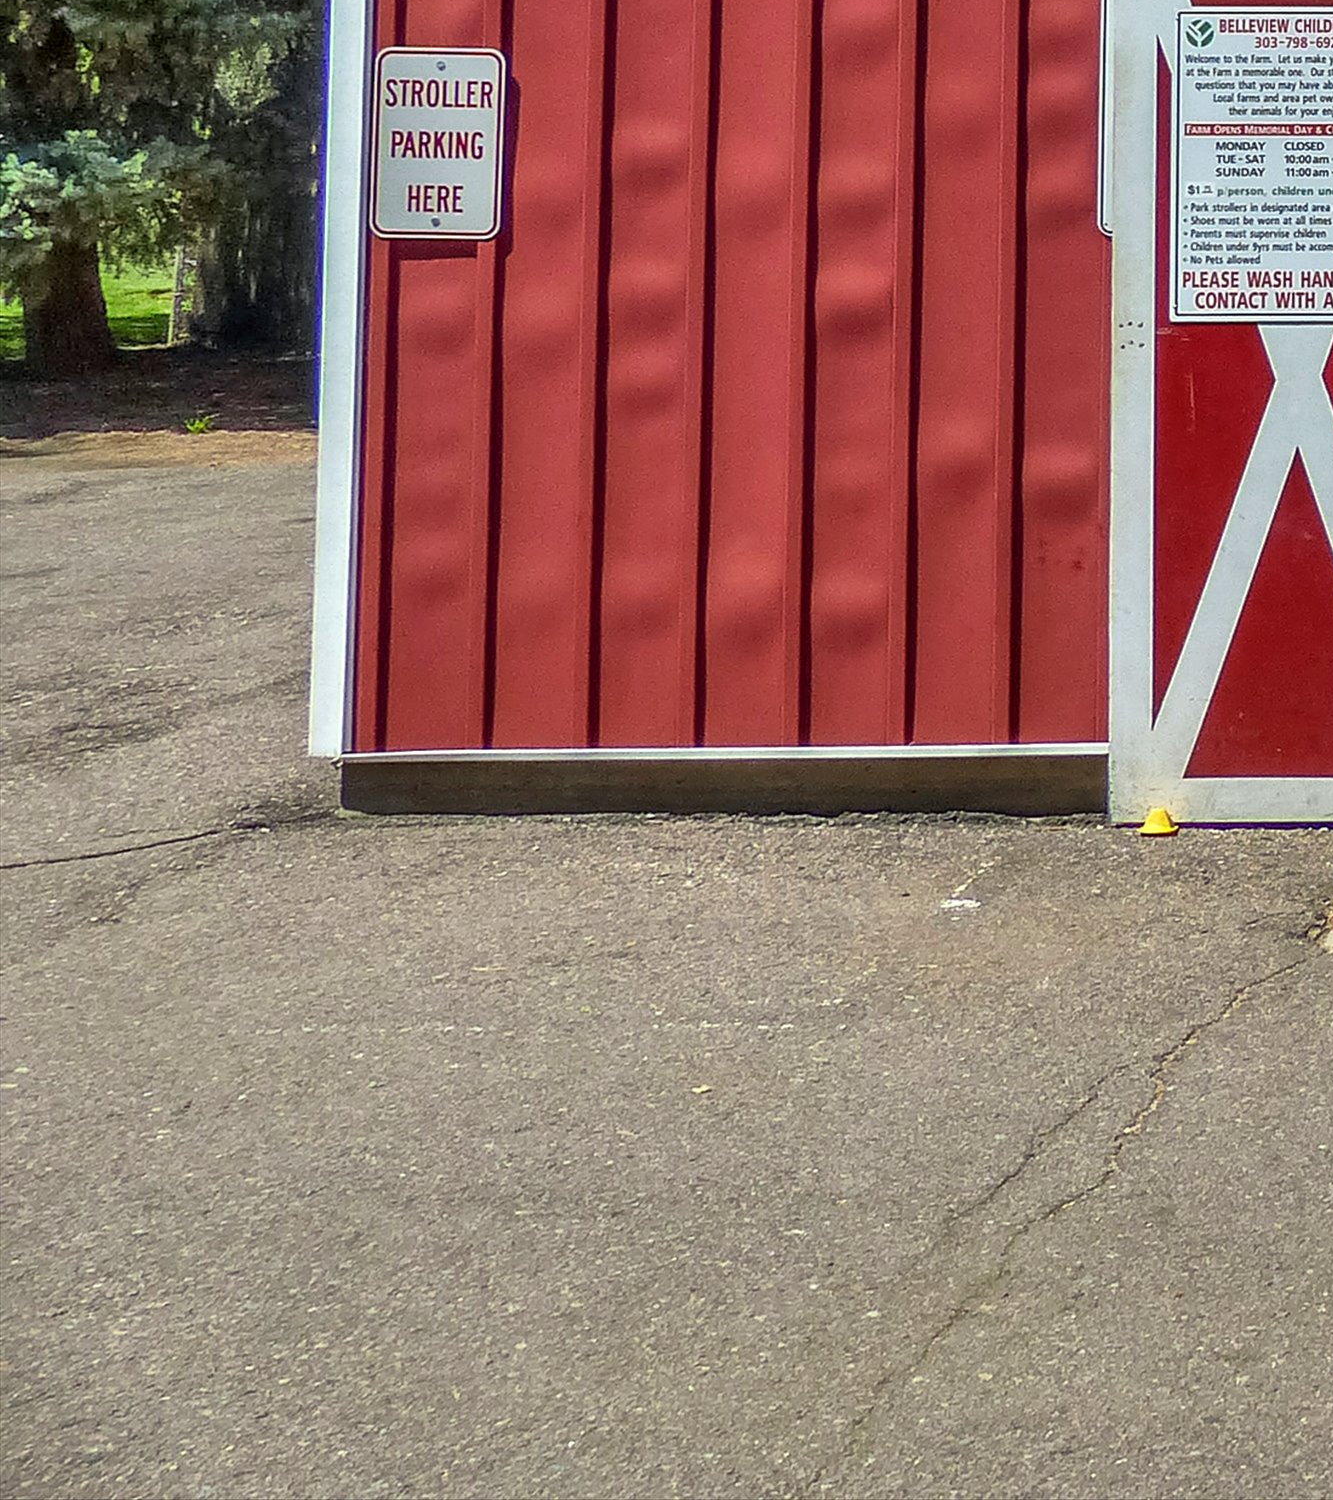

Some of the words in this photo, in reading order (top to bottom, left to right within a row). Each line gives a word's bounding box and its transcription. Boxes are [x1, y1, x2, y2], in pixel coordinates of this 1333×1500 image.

[1219, 19, 1289, 33] BELLEVIEW
[1185, 54, 1220, 63] Welcome
[1224, 55, 1232, 63] to
[1236, 54, 1248, 63] the
[1278, 55, 1290, 63] Let
[1305, 54, 1326, 63] make
[1197, 68, 1210, 76] the
[1213, 68, 1231, 76] Farm
[1242, 68, 1285, 76] memorable
[1311, 68, 1325, 76] Our
[1195, 82, 1235, 91] questions
[1239, 81, 1256, 89] that
[1260, 83, 1275, 91] you
[1278, 83, 1296, 91] may
[1300, 81, 1319, 89] have
[385, 79, 493, 108] STROLLER
[1213, 94, 1233, 102] Local
[1238, 94, 1260, 102] farms
[1264, 94, 1279, 102] and
[1303, 95, 1316, 104] pet
[1229, 107, 1247, 115] their
[1251, 107, 1281, 115] animals
[1286, 107, 1297, 115] for
[1301, 109, 1319, 117] your
[1187, 125, 1211, 134] FARM
[1214, 125, 1241, 134] OPENS
[1245, 125, 1290, 134] MEMORIAL
[1294, 125, 1312, 134] DAY
[1316, 126, 1322, 134] &
[391, 131, 484, 159] PARKING
[1216, 142, 1266, 151] MONDAY
[1284, 142, 1324, 151] CLOSED
[1216, 168, 1265, 177] SUNDAY
[1272, 186, 1313, 195] children
[407, 185, 464, 213] HERE
[1191, 203, 1208, 211] Park
[1213, 203, 1246, 211] strollers
[1251, 203, 1258, 211] in
[1261, 203, 1308, 214] designated
[1191, 216, 1215, 225] Shoes
[1219, 217, 1240, 225] must
[1243, 217, 1253, 225] be
[1283, 217, 1292, 225] at
[1296, 216, 1305, 225] all
[1309, 216, 1332, 225] times
[1191, 230, 1222, 238] Parents
[1226, 230, 1246, 238] must
[1250, 230, 1289, 240] supervise
[1294, 229, 1326, 238] children
[1191, 242, 1223, 251] Children
[1226, 242, 1249, 251] under
[1296, 243, 1306, 251] be
[1191, 256, 1202, 264] No
[1206, 256, 1223, 264] Pets
[1227, 255, 1260, 264] allowed
[1183, 271, 1239, 288] PLEASE
[1247, 271, 1293, 288] WASH
[1195, 292, 1268, 308] CONTACT
[1275, 292, 1315, 308] WITH
